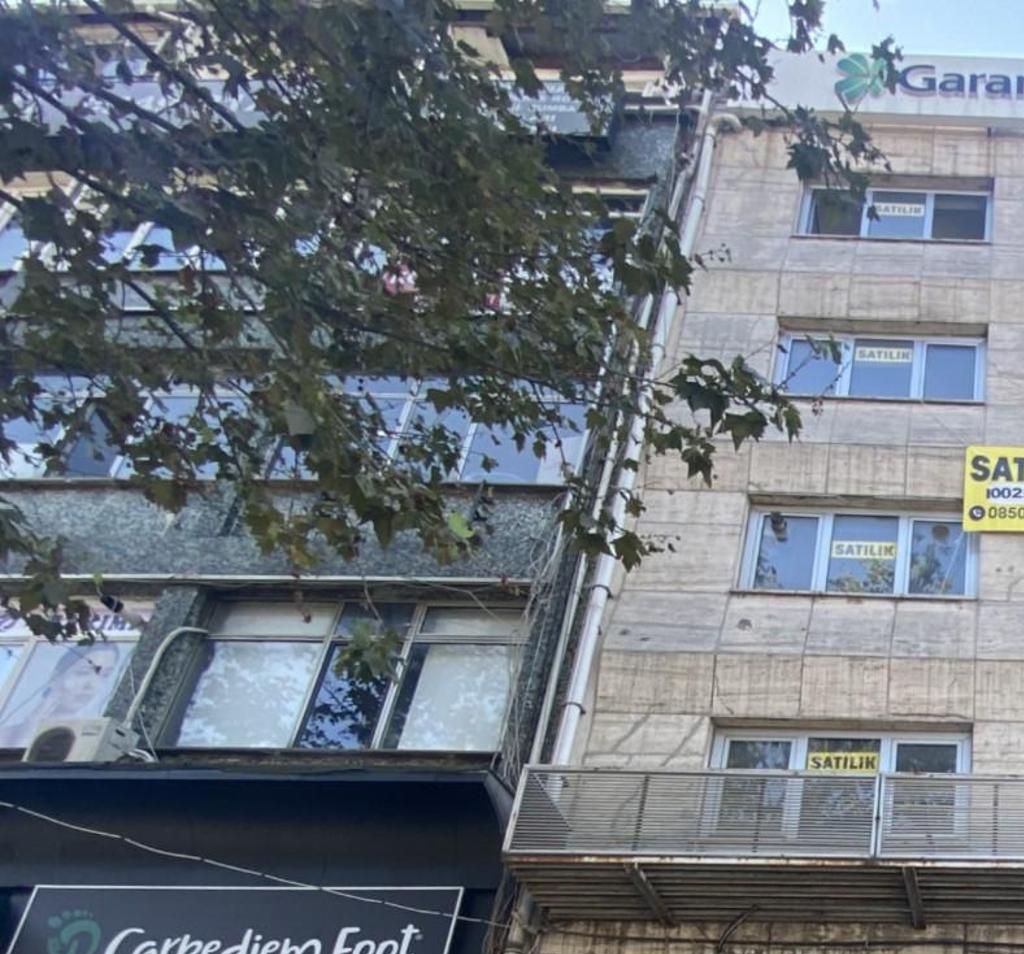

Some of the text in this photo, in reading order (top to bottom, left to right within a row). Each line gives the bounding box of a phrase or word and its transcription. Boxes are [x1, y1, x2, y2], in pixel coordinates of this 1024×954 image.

[857, 349, 911, 361] SATILIK
[834, 543, 896, 556] SATILIK
[811, 755, 877, 771] SATILIK
